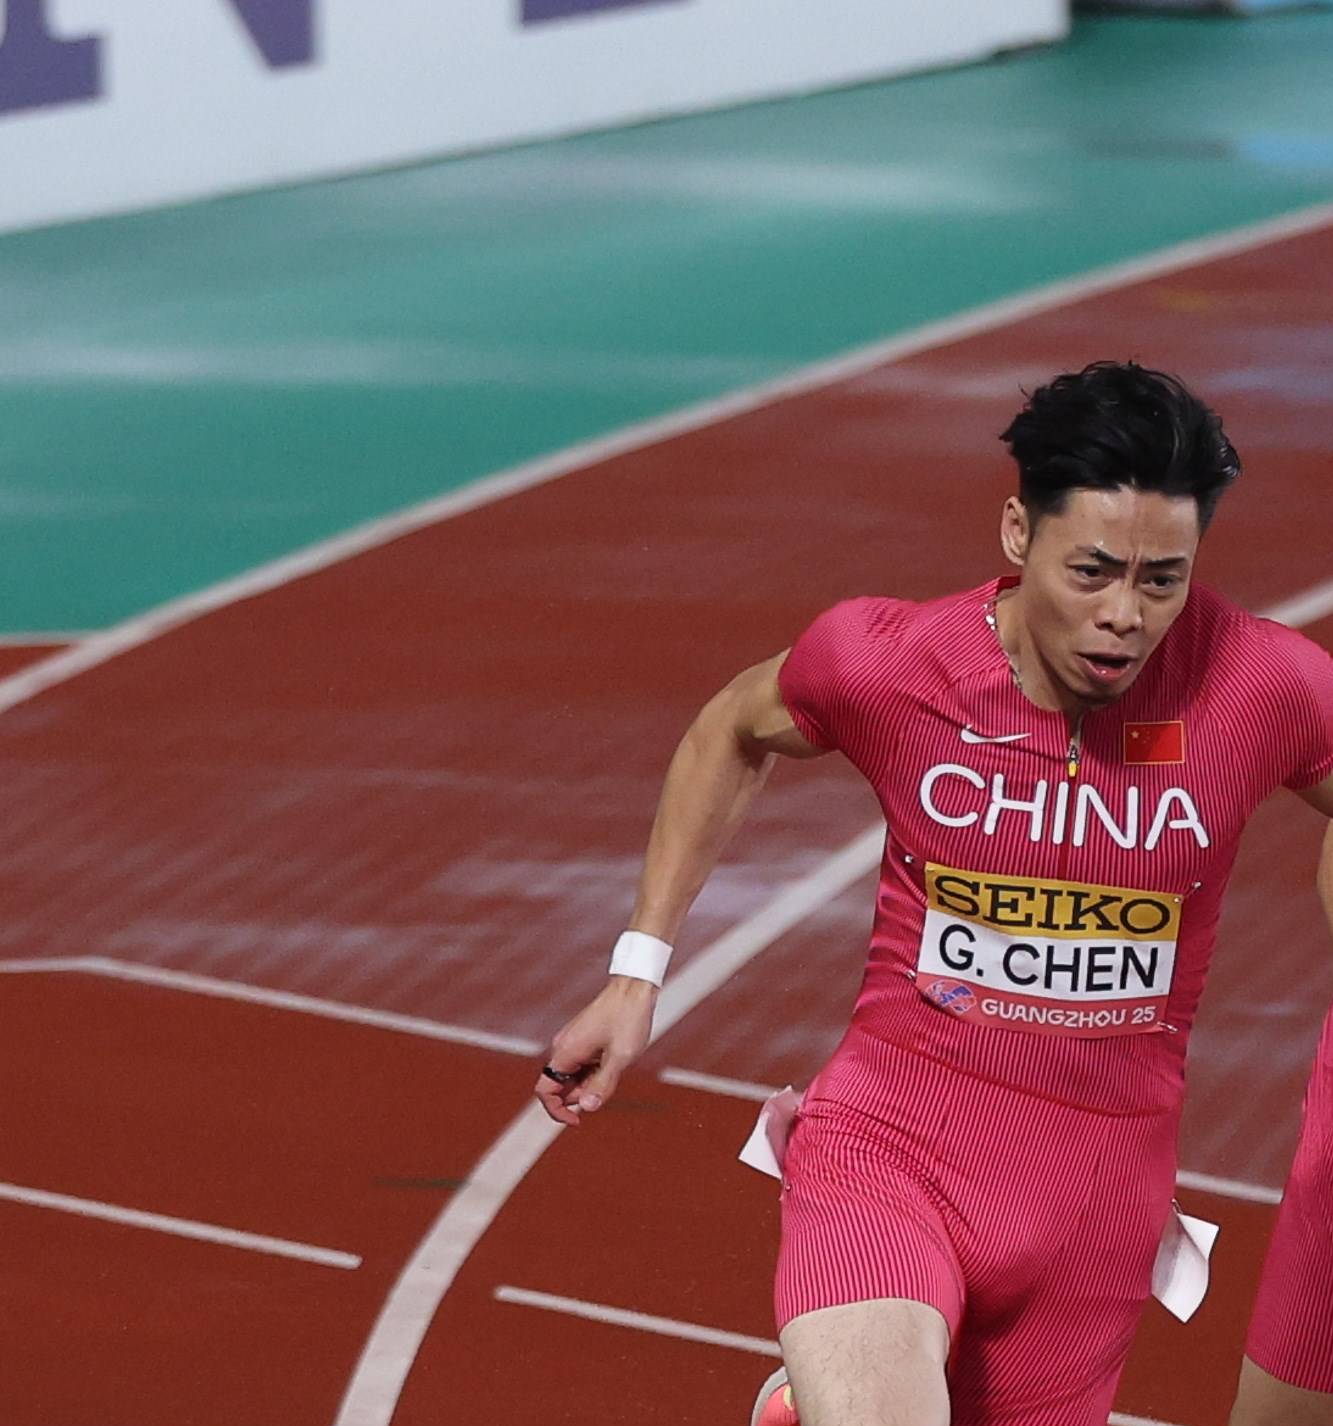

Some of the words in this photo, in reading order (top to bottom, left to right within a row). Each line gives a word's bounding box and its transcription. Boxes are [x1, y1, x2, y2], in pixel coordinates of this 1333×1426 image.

[920, 763, 1210, 850] CHINA
[934, 875, 1170, 934] SEIKO
[939, 924, 984, 977] G.
[1002, 943, 1159, 992] CHEN
[981, 999, 1127, 1028] GUANGZHOU
[1132, 1006, 1156, 1025] 25
